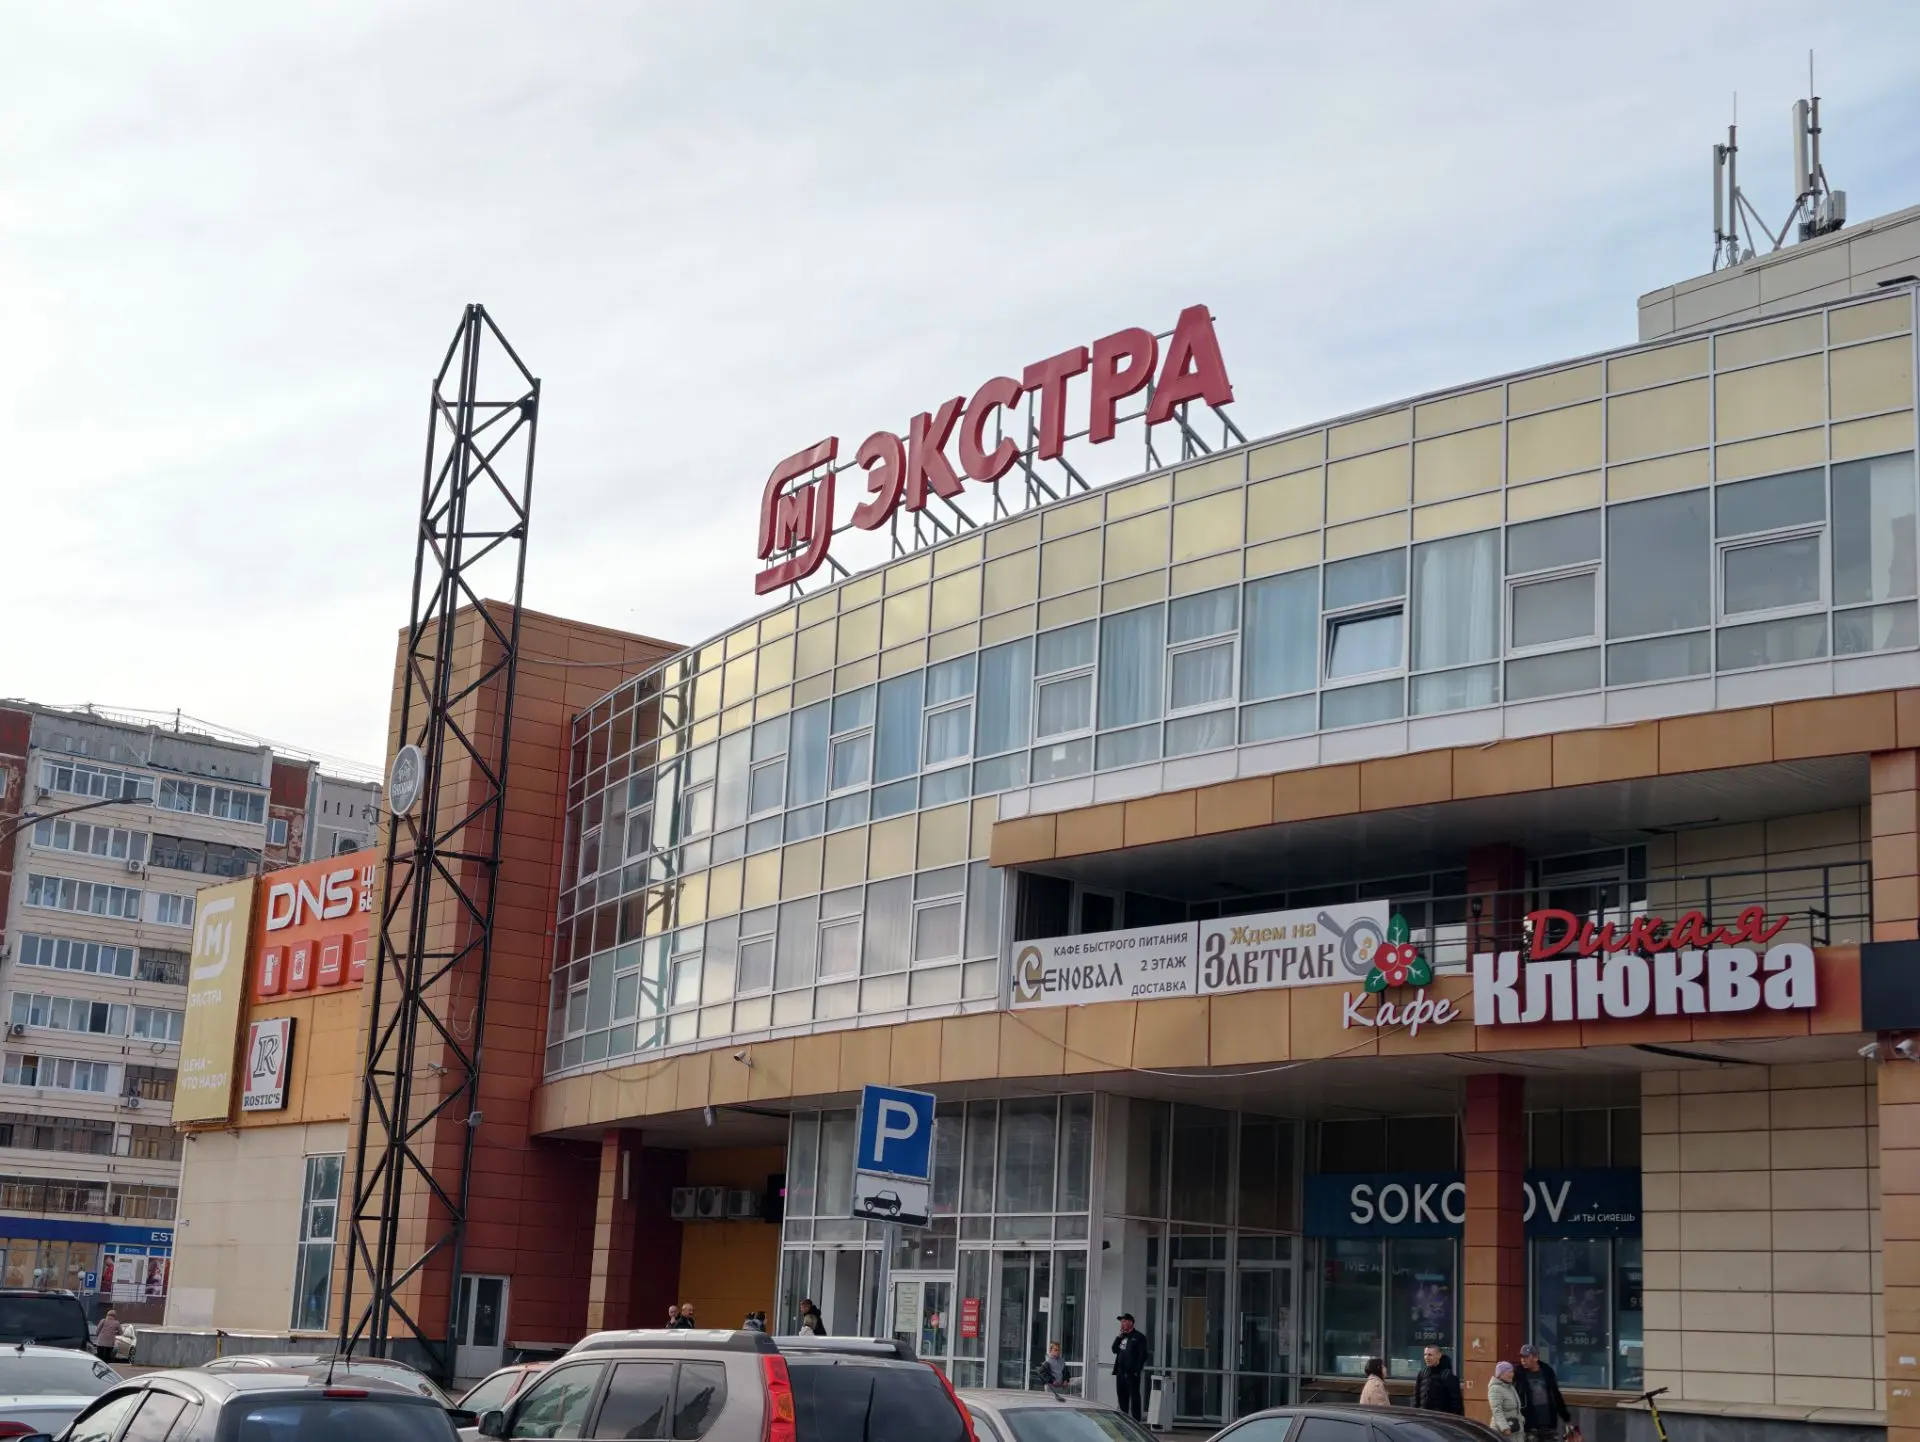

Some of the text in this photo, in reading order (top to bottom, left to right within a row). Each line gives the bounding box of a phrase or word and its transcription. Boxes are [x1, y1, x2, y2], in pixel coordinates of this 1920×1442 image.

[850, 304, 1235, 531] ЭКСТРА
[266, 867, 355, 931] DNS
[1054, 932, 1188, 956] КАФЕ БЫСТРОГО ПИТАНИЯ
[1229, 923, 1316, 946] Ждем на
[1525, 906, 1790, 961] Дикая
[1140, 956, 1188, 972] 2 ЭТАЖ
[1204, 932, 1335, 989] ЗАВТРАК
[1018, 952, 1124, 999] СЕНОВАЛ
[188, 989, 222, 1007] ЭКСТРА
[1131, 981, 1187, 996] ДОСТАВКА
[1343, 988, 1461, 1036] Кафе
[183, 1058, 207, 1072] ЦЕНА
[181, 1072, 228, 1090] ЧТО НАДО!
[244, 1092, 281, 1107] ROSTIC'S
[873, 1099, 919, 1162] P
[1350, 1181, 1571, 1224] SOKOV
[1582, 1214, 1596, 1222] ТЫ
[1597, 1213, 1636, 1222] СИЯЕШЬ
[87, 1273, 95, 1286] P
